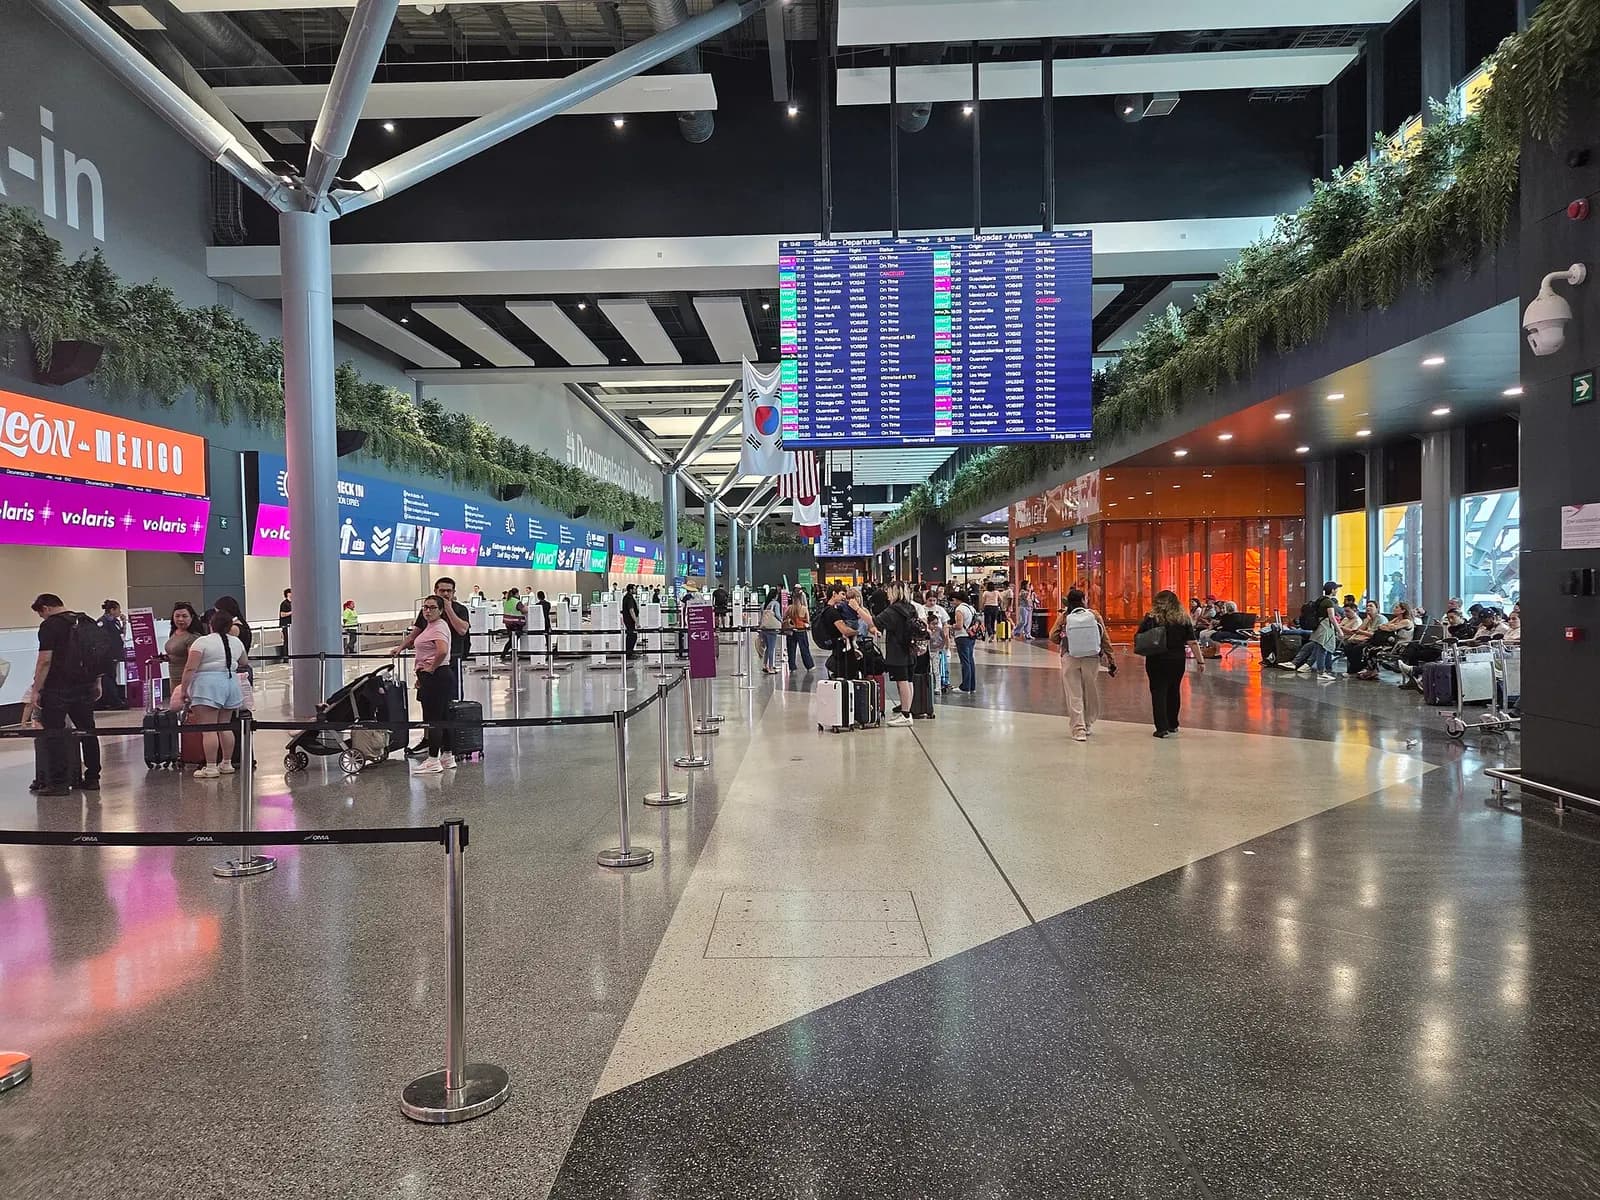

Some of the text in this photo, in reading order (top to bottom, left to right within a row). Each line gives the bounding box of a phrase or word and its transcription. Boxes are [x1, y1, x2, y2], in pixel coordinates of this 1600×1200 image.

[0, 105, 105, 242] -in
[842, 238, 880, 247] Departures
[972, 233, 1002, 242] Llegadas
[95, 428, 183, 476] MÉXICO
[61, 508, 115, 528] volaris
[143, 515, 187, 533] volaris
[442, 544, 467, 555] volaris
